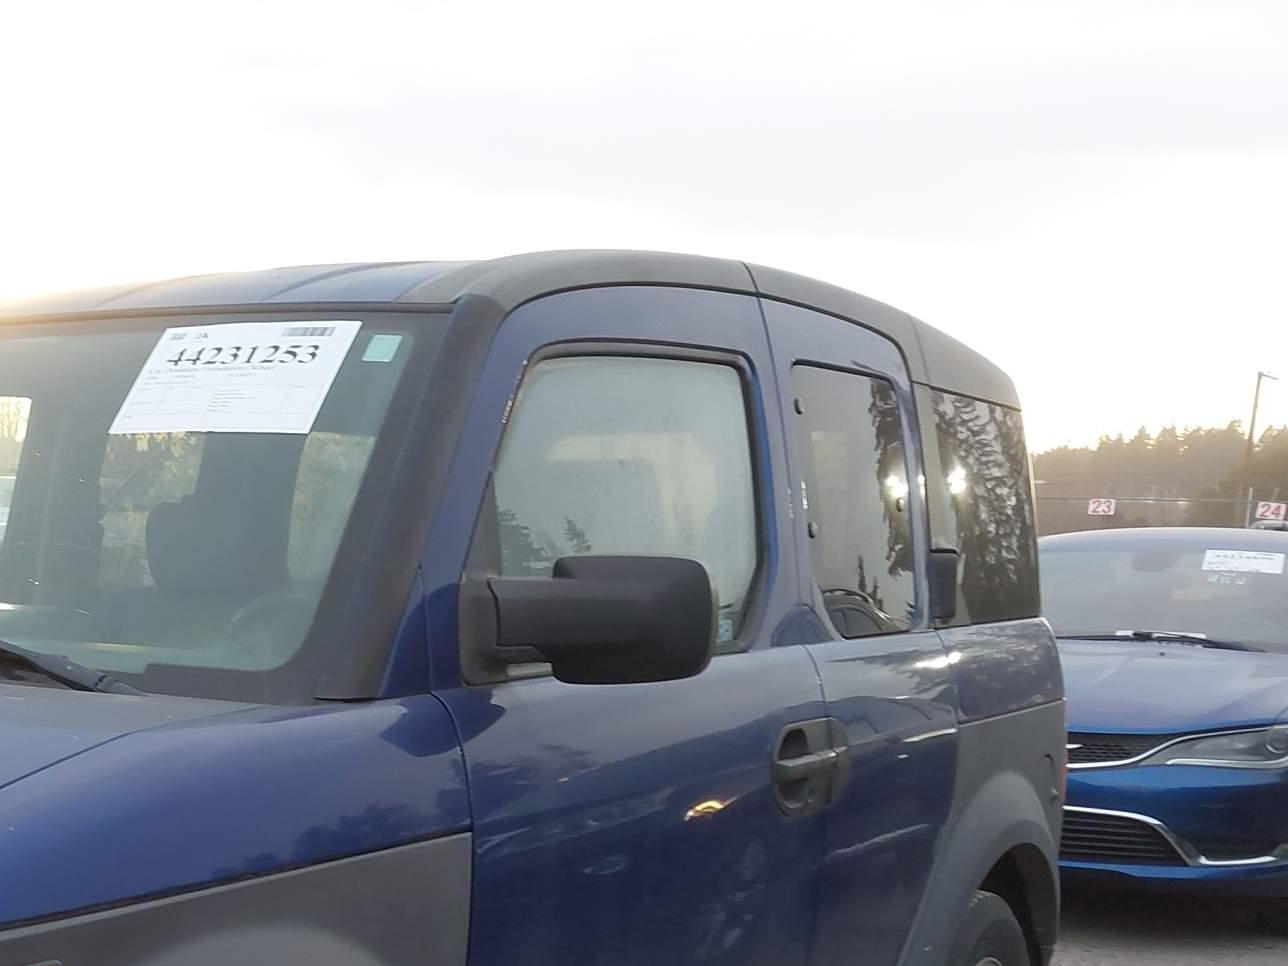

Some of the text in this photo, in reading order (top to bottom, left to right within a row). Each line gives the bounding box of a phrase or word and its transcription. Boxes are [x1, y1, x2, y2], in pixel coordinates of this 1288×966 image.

[166, 344, 320, 366] 44231253
[1091, 499, 1112, 514] 23
[1259, 503, 1283, 518] 24
